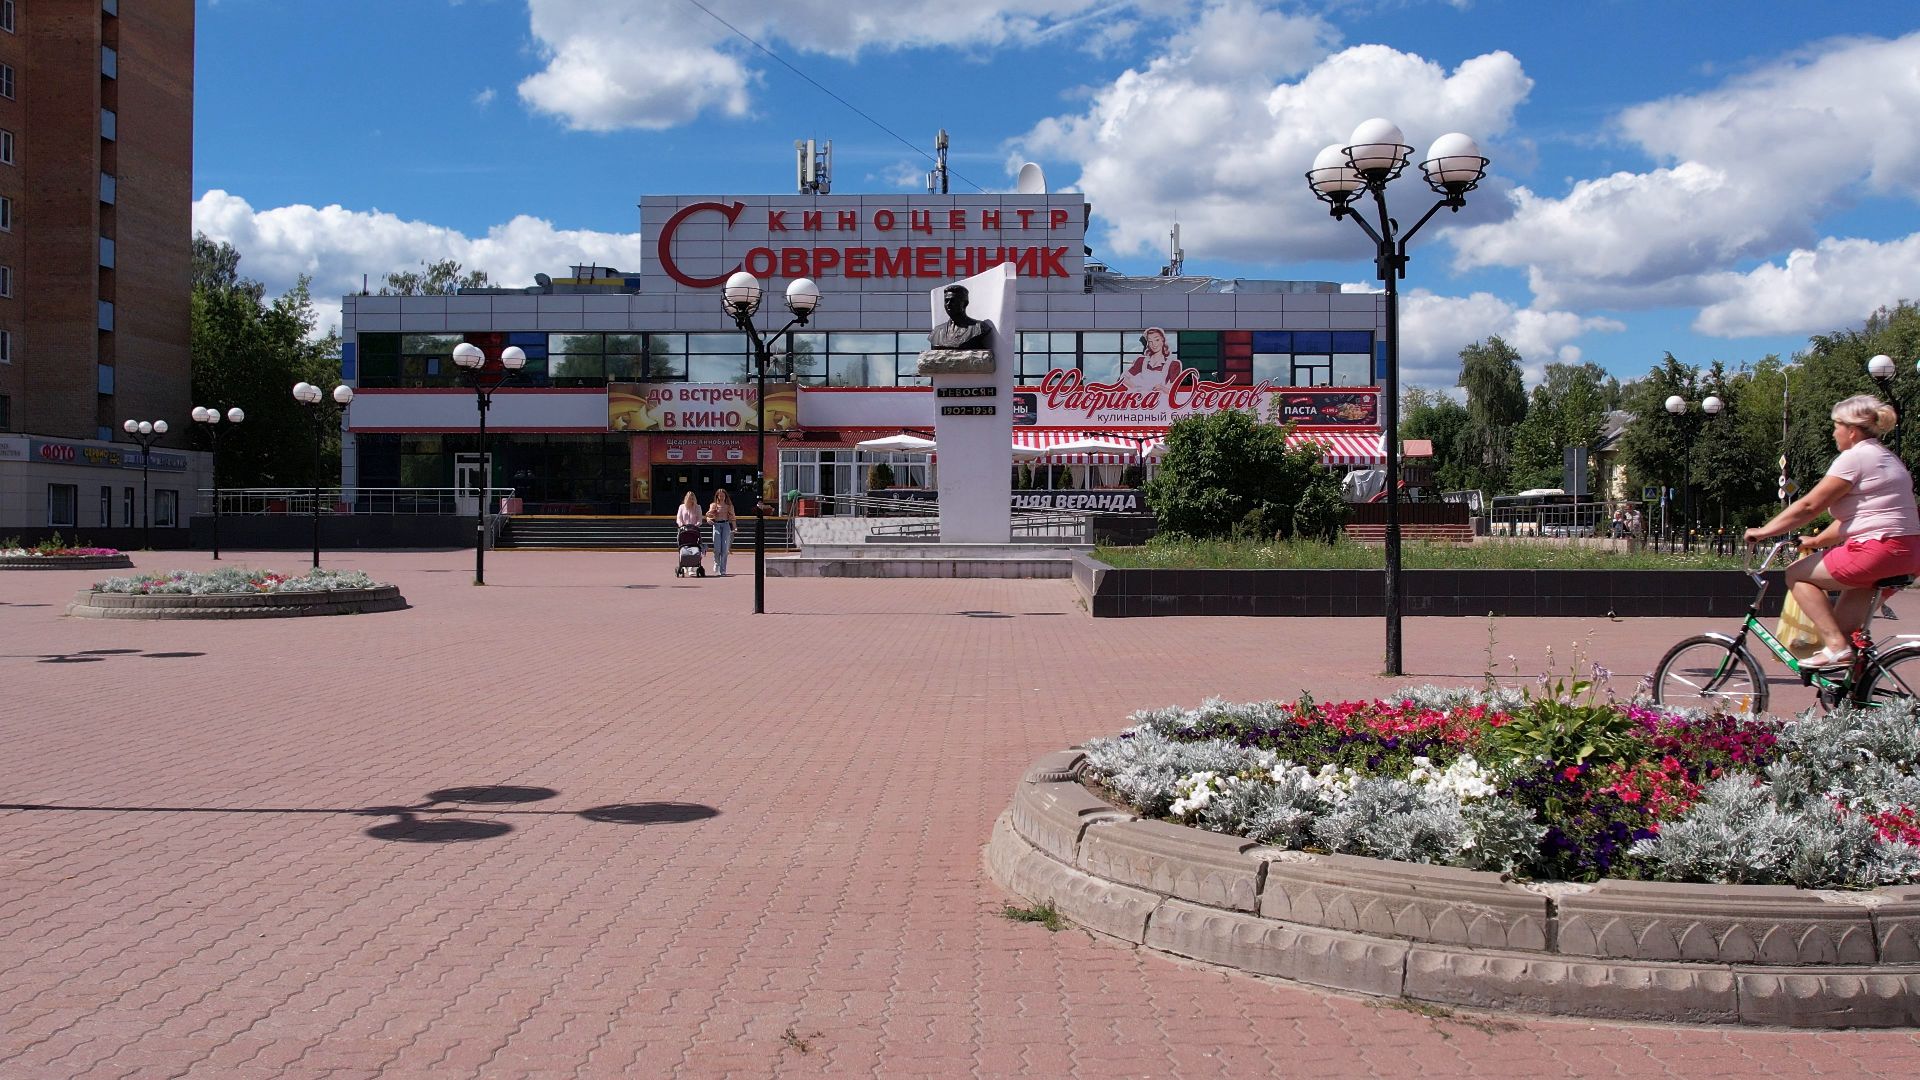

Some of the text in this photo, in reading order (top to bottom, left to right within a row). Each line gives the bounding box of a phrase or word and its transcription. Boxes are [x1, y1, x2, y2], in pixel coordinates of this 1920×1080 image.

[767, 209, 1069, 235] КИНОЦЕНТР
[647, 387, 758, 405] до встречи
[940, 387, 994, 397] ТЕВОСЯН
[1039, 367, 1162, 420] Фабрика
[943, 406, 993, 415] 1902-1958
[1097, 411, 1166, 423] кулинарный
[1284, 406, 1317, 415] ПАСТА
[663, 411, 742, 428] В КИНО
[41, 444, 76, 460] ФОТО
[1055, 494, 1137, 511] ВЕРАНДА
